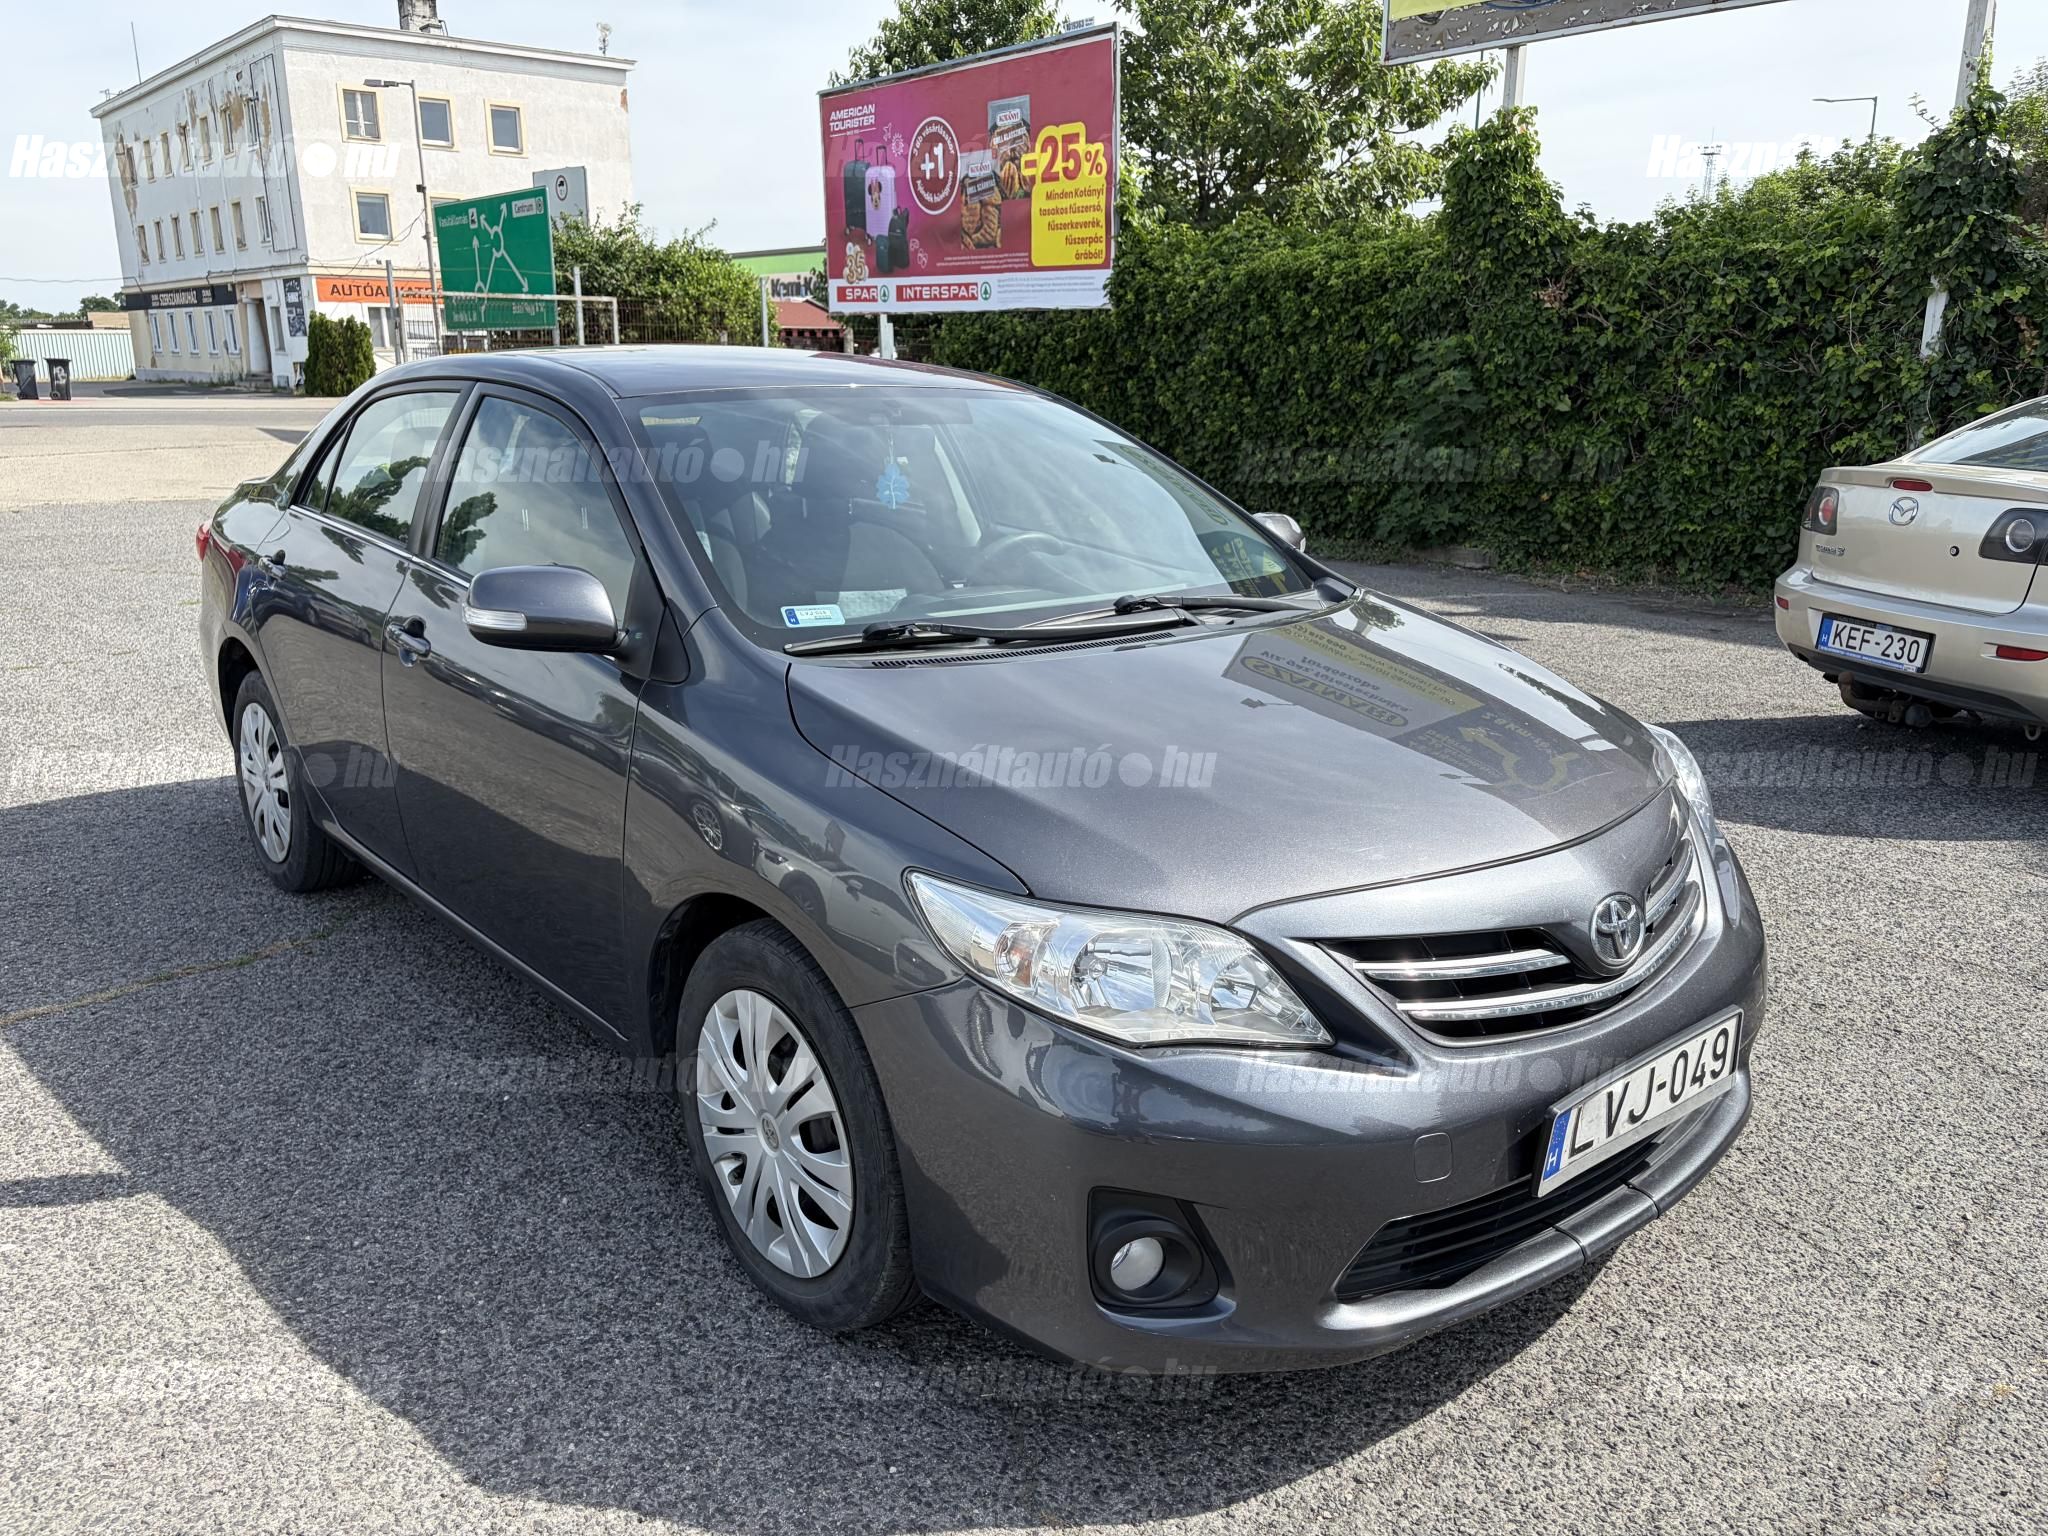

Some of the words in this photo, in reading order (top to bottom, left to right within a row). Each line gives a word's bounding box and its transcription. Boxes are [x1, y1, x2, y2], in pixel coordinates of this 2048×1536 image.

[829, 104, 876, 121] AMERICAN
[829, 115, 875, 132] TOURISTER
[920, 142, 944, 180] +1
[1045, 190, 1073, 201] Minden
[1074, 184, 1104, 200] Kotányi
[1039, 207, 1069, 217] tasakos
[1068, 203, 1103, 216] fűszersó,
[1047, 220, 1104, 232] fűszerkeverék,
[1065, 235, 1103, 247] fűszerpác
[1074, 249, 1103, 261] árából!
[845, 286, 878, 300] SPAR
[903, 282, 978, 299] INTERSPAR
[1821, 633, 1828, 642] H
[1832, 623, 1920, 664] KEF-230
[1568, 1027, 1730, 1160] LVJ-049
[1546, 1148, 1557, 1172] H
